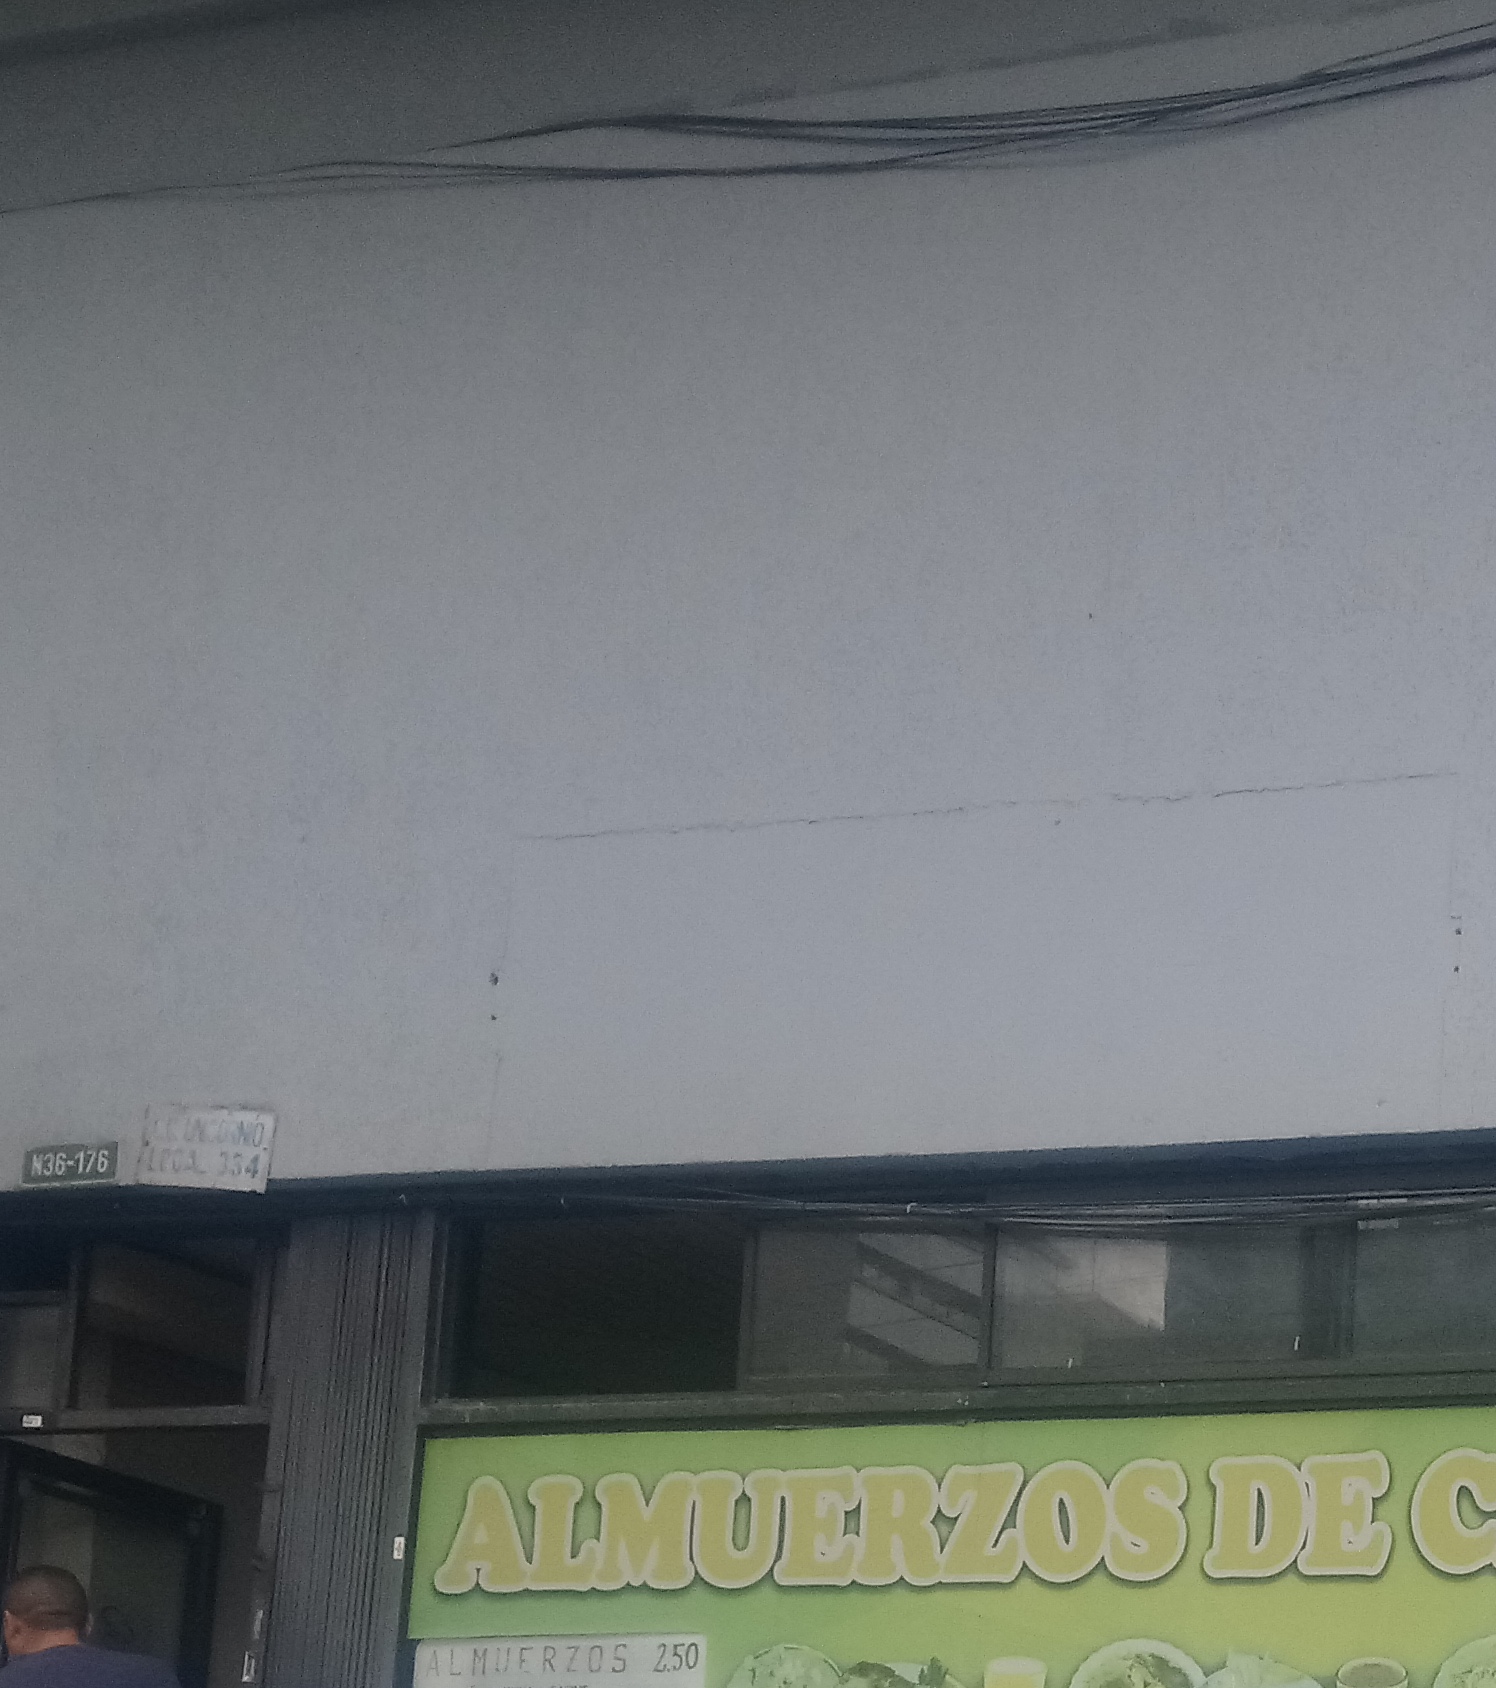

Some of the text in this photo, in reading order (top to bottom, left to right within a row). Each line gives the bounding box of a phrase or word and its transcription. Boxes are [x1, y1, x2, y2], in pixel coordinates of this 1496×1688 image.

[31, 1151, 109, 1177] N36-176
[434, 1458, 1189, 1594] ALMUERZOS
[1203, 1450, 1392, 1578] DE
[426, 1643, 627, 1676] ALMUERZOS
